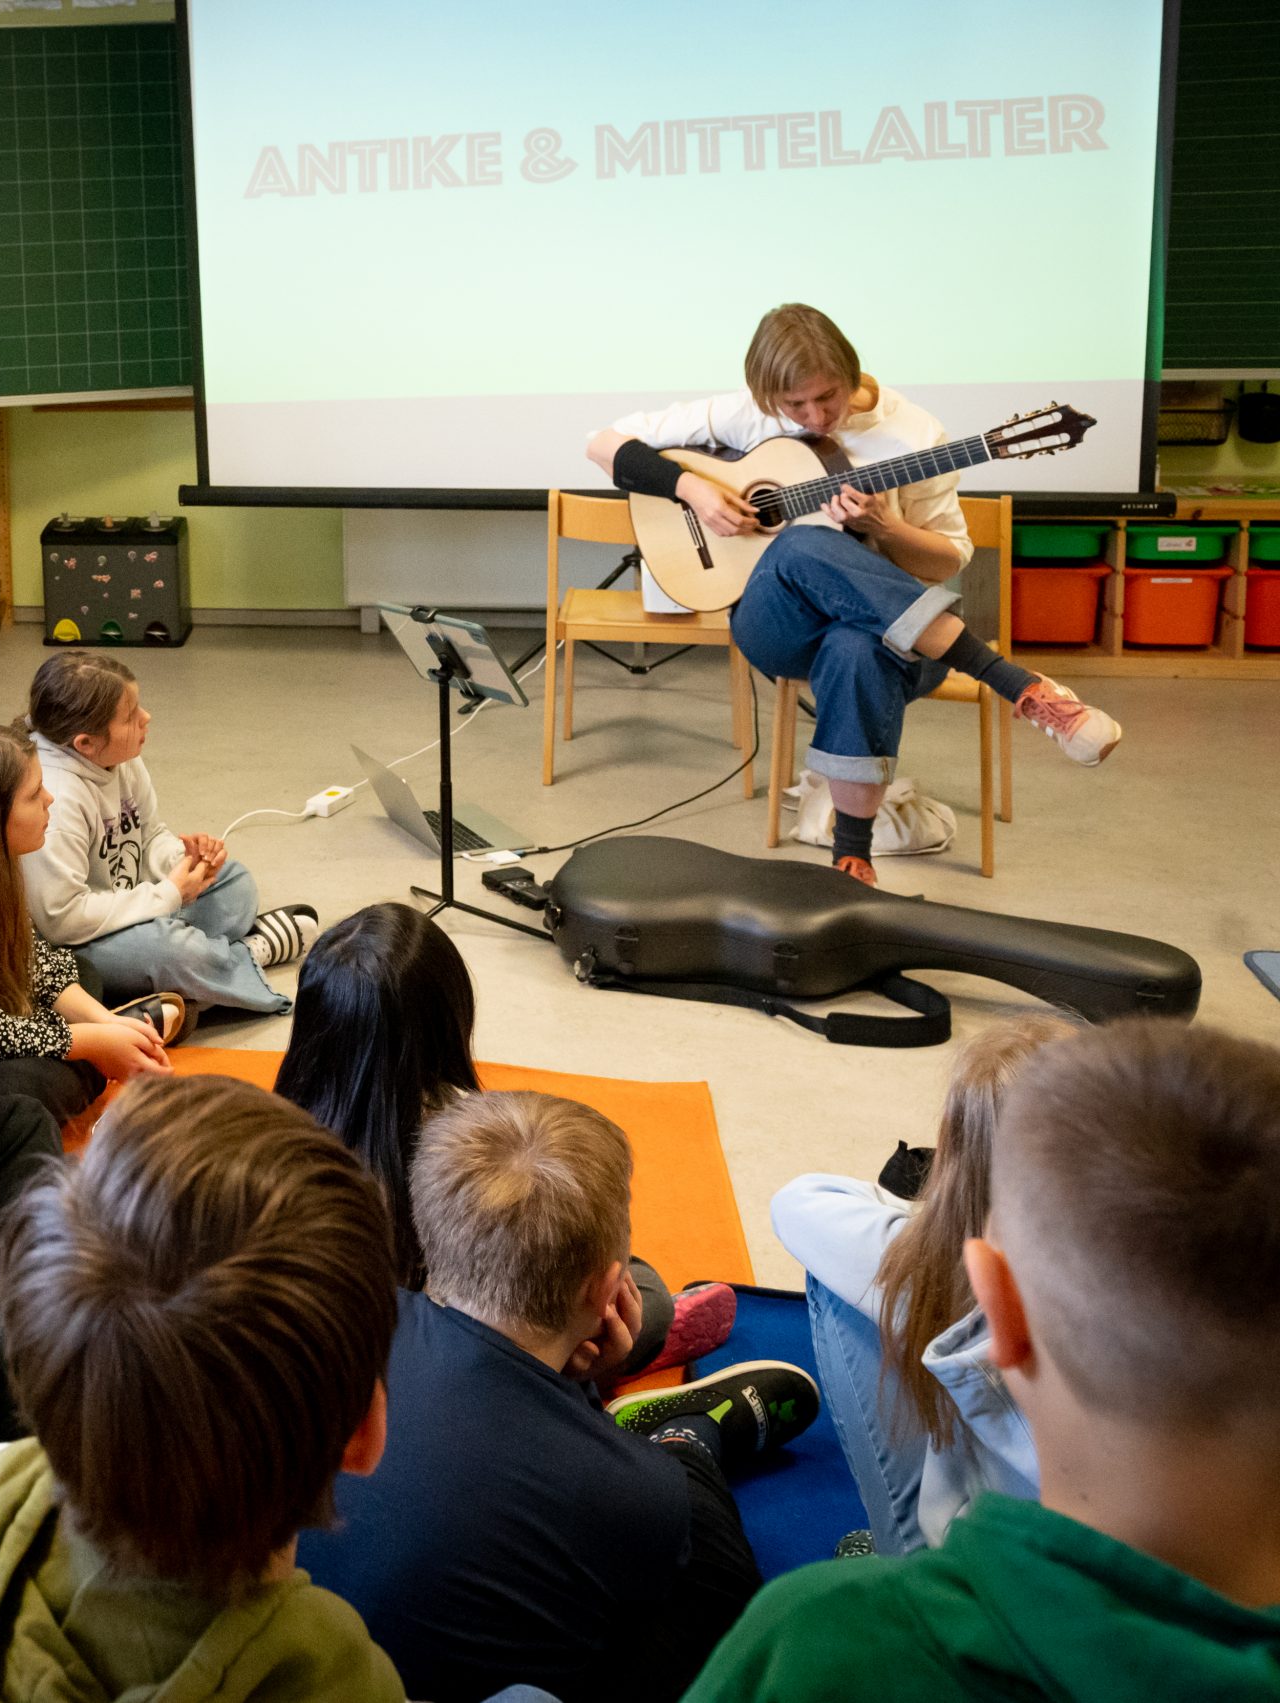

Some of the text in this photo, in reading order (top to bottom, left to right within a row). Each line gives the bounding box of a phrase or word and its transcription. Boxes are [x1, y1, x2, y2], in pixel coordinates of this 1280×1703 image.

[243, 93, 1110, 200] ANTIKE & MITTELALTER
